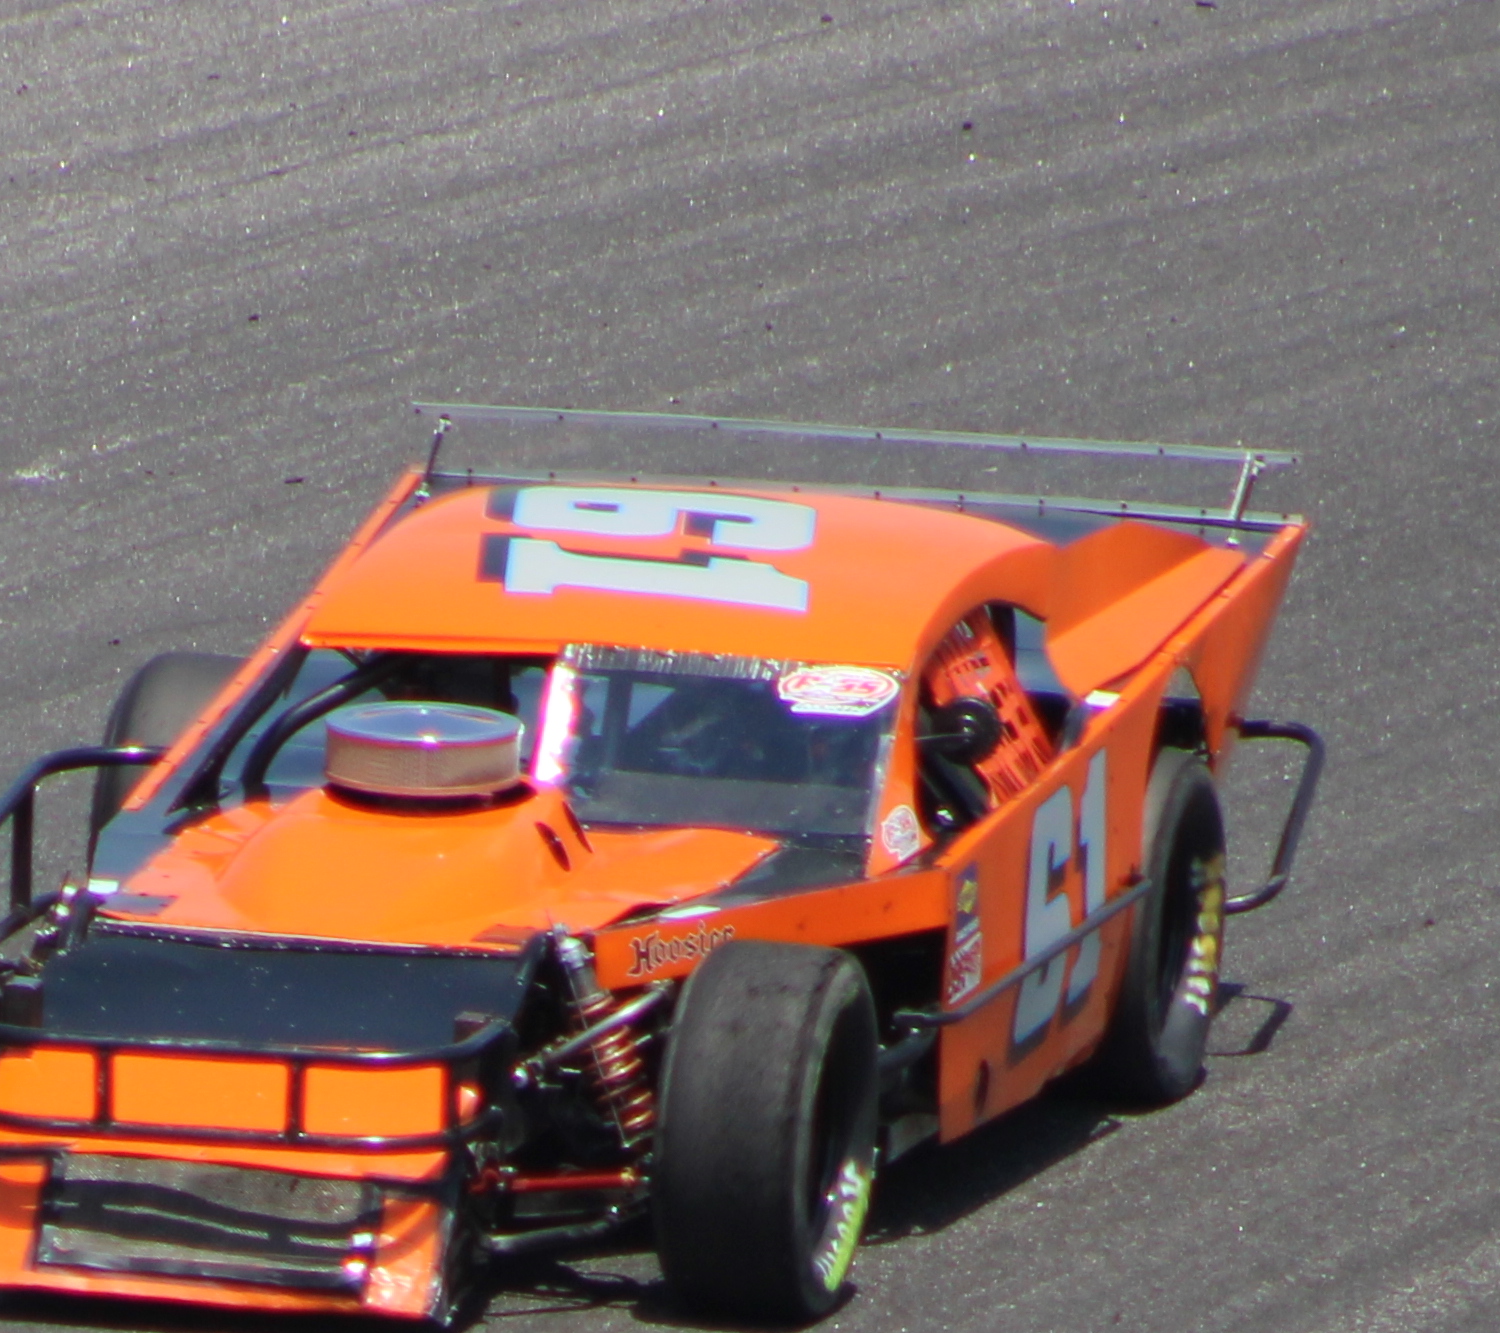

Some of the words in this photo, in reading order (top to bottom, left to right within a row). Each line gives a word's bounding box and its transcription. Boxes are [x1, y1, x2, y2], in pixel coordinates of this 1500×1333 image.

[492, 484, 820, 615] 61
[626, 919, 736, 977] Hoosier
[1010, 745, 1108, 1048] 61
